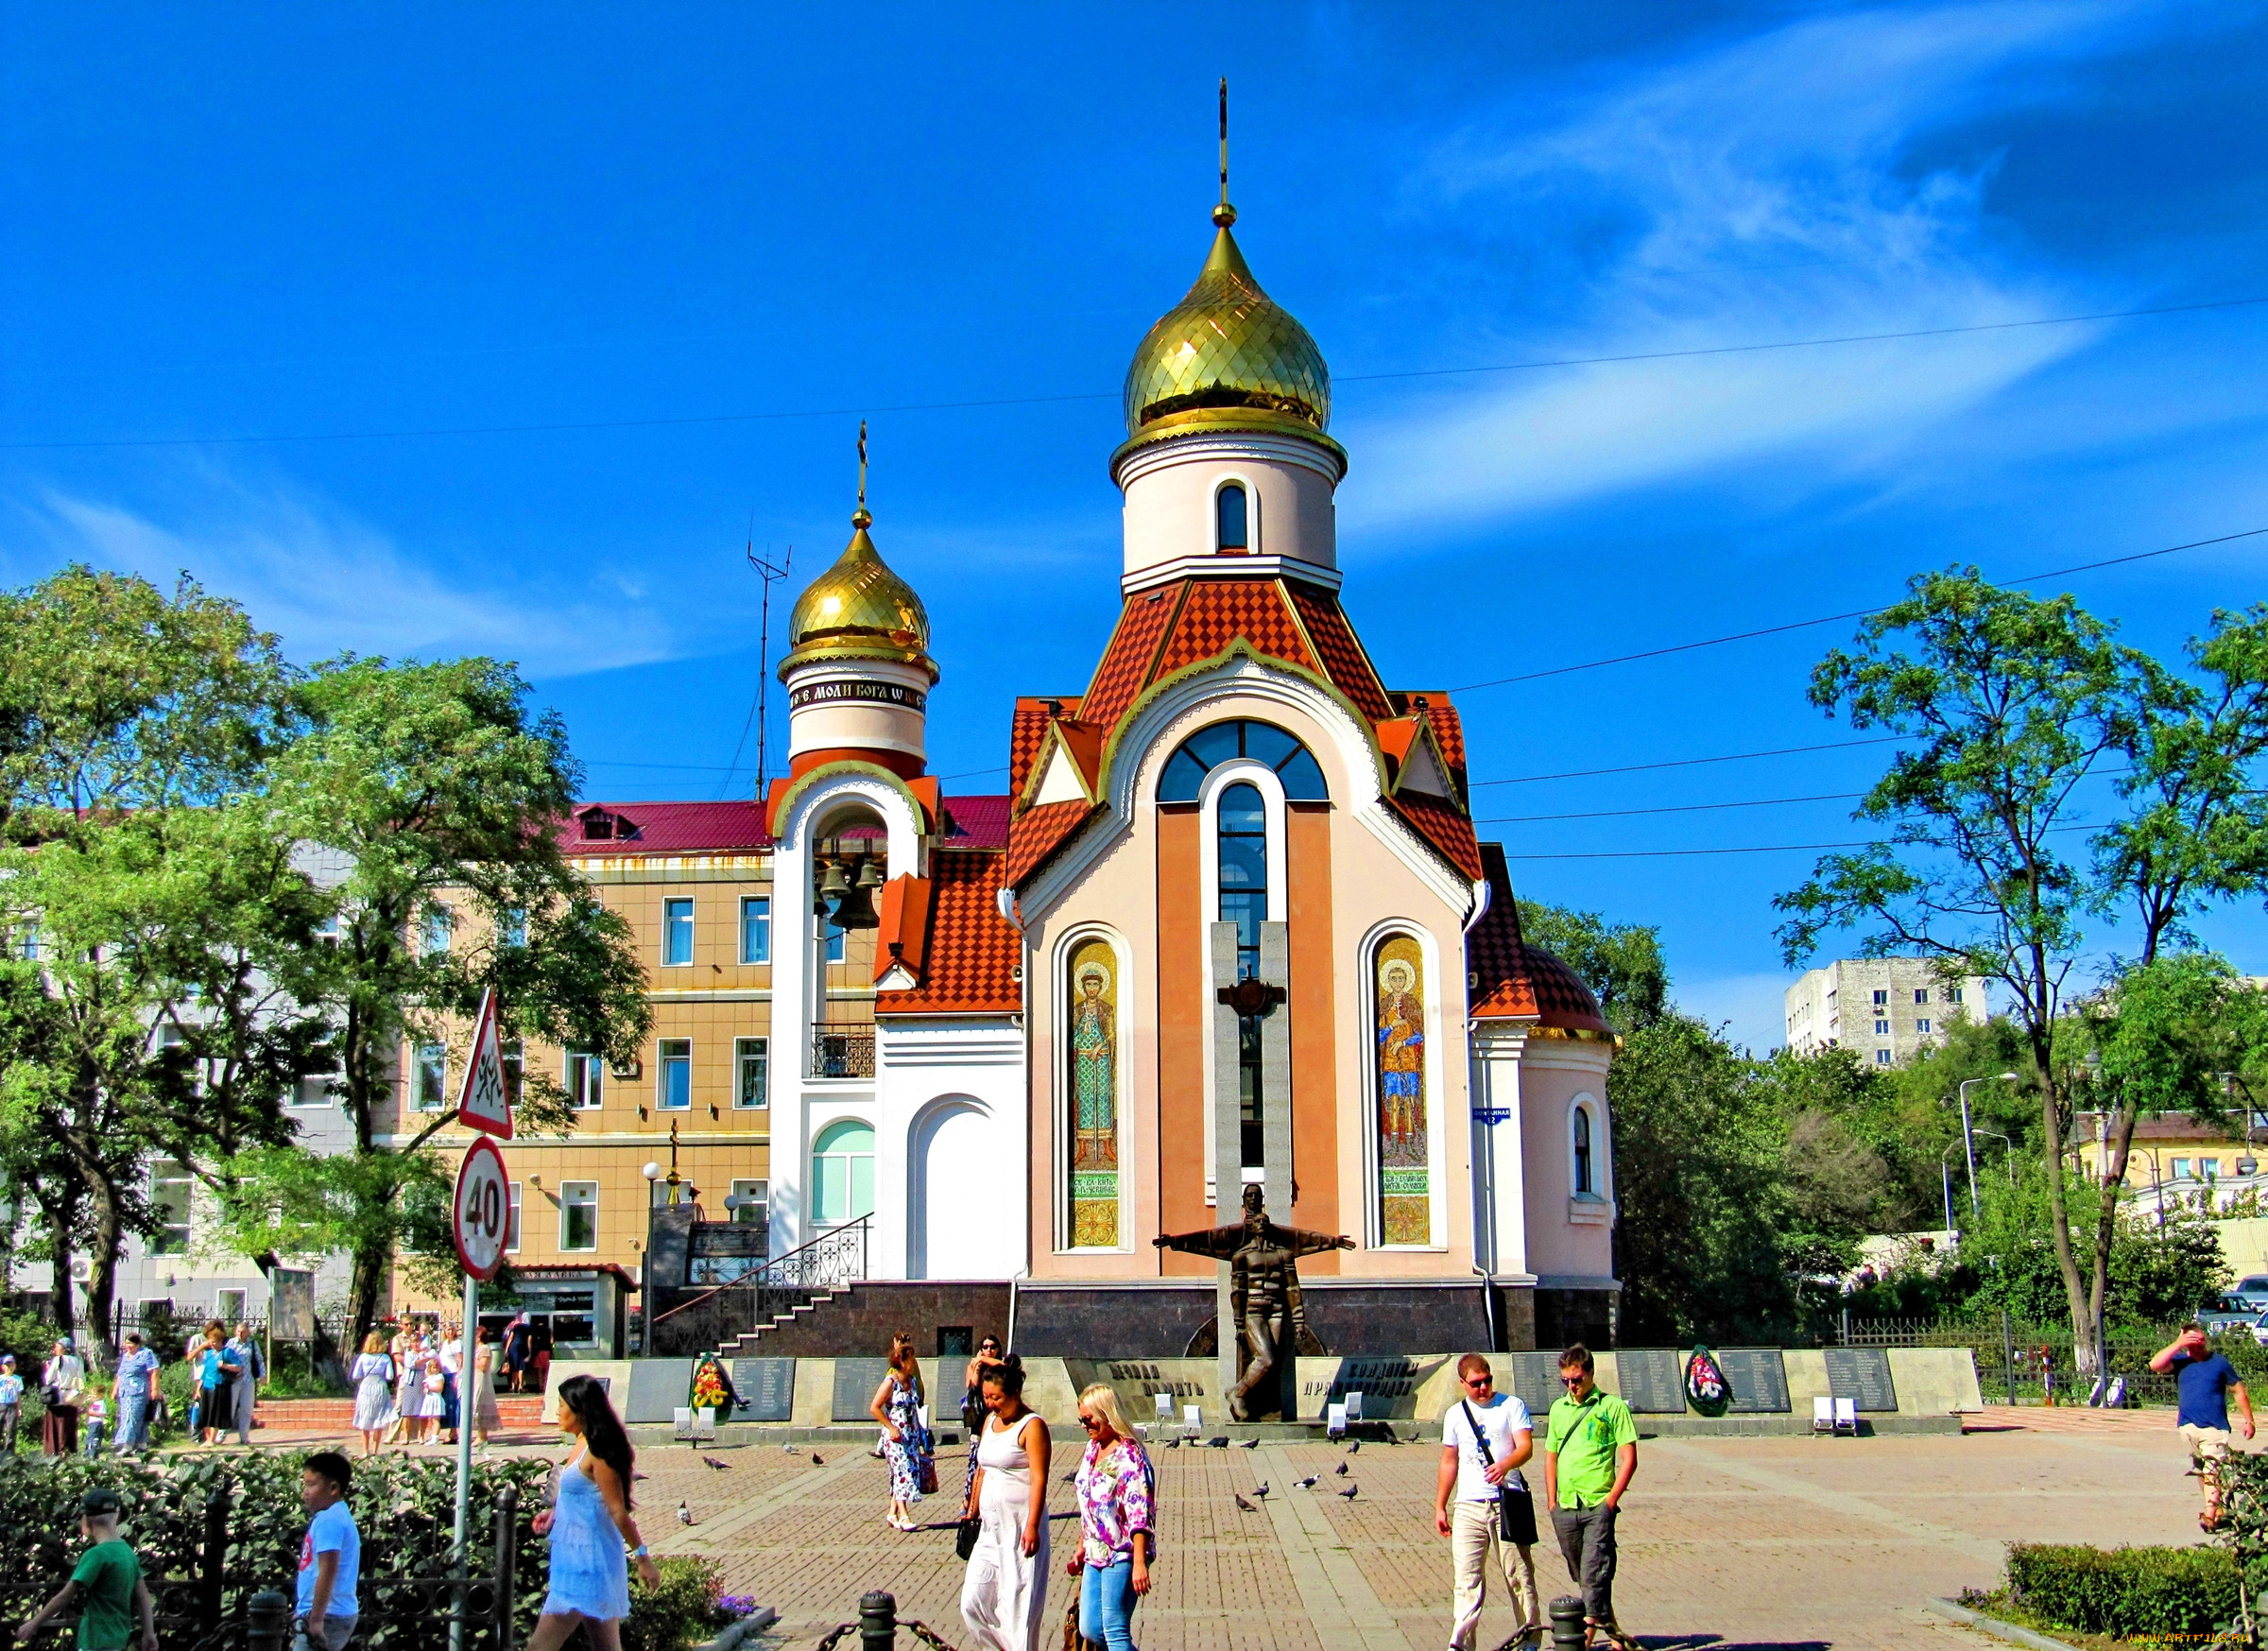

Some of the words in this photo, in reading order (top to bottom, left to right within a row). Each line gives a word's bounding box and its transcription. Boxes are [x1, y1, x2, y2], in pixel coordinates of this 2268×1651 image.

[814, 684, 852, 699] МОЛИ
[856, 685, 888, 699] БОГА
[466, 1175, 500, 1239] 40
[1349, 1362, 1419, 1380] СОЛДАТАМ
[1142, 1382, 1205, 1397] ПАМЯТЬ
